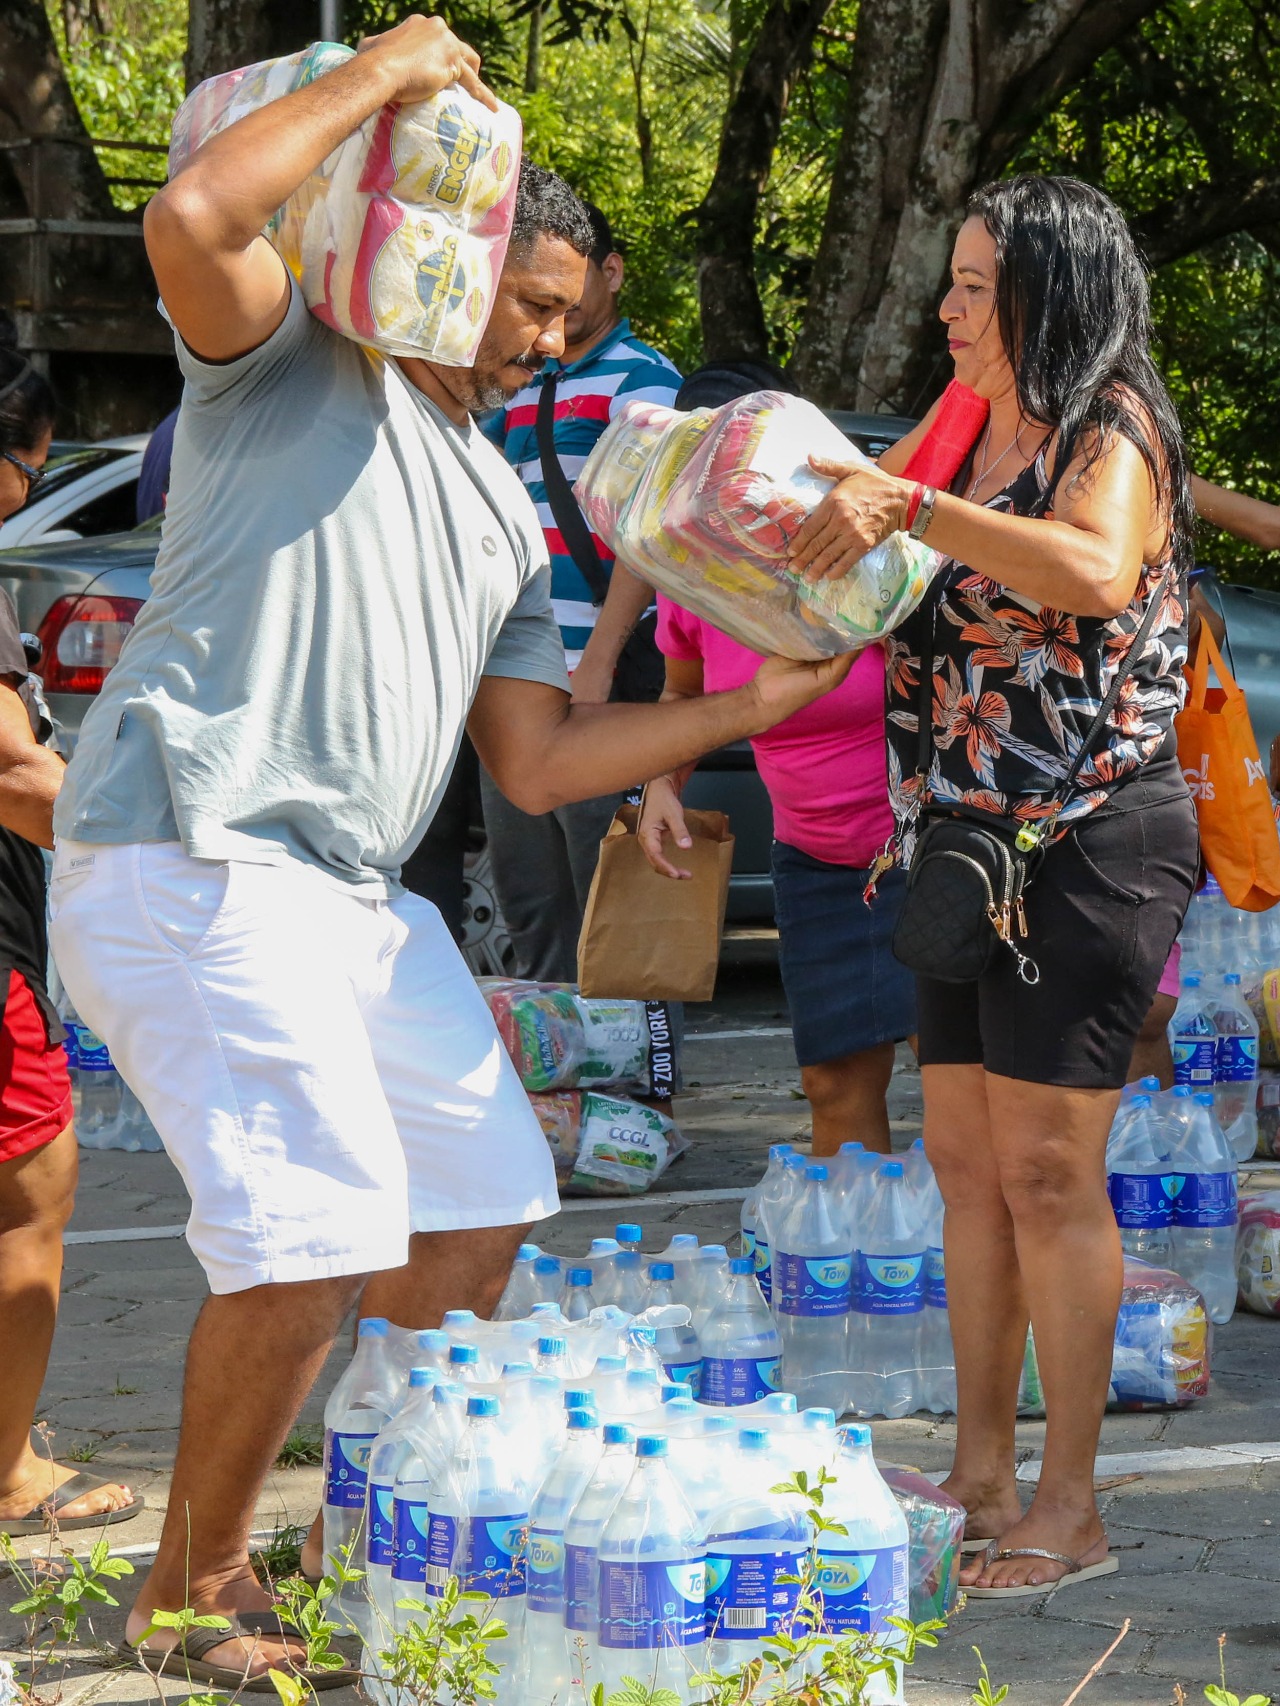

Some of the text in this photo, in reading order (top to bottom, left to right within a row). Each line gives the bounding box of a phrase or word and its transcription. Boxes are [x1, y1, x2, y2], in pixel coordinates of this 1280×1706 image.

[436, 120, 484, 204] ENGEN
[427, 163, 442, 195] ARROZ
[648, 1008, 673, 1082] ZOO YORK
[609, 1127, 650, 1147] CCGL
[823, 1266, 849, 1280] TOYA
[883, 1266, 909, 1280] TOYA
[530, 1542, 555, 1562] TOYA
[689, 1573, 705, 1593] TOY
[816, 1569, 850, 1584] TOYA
